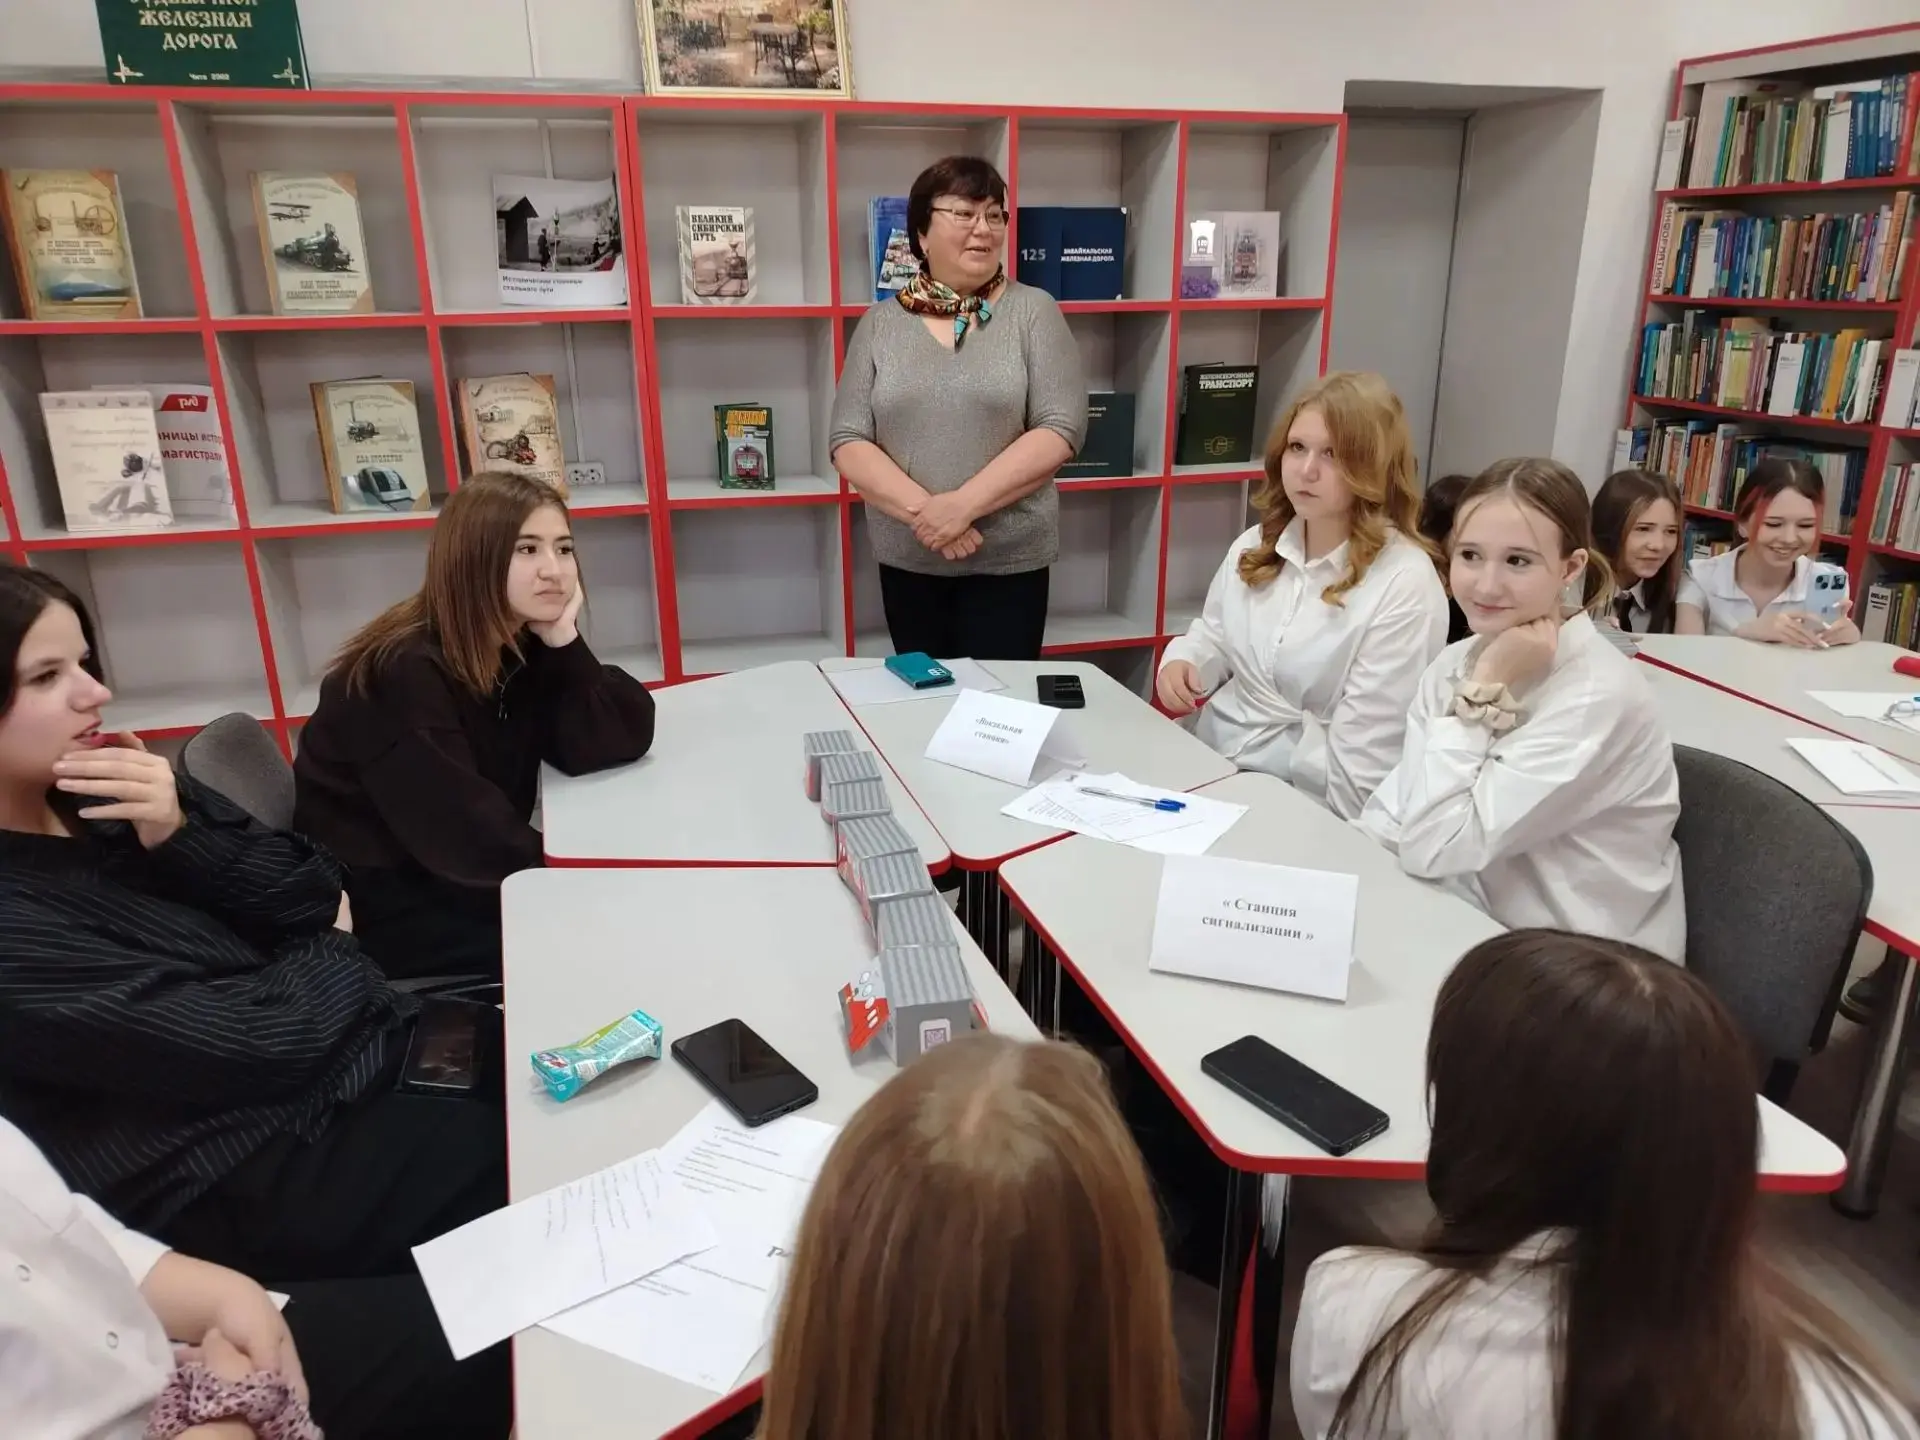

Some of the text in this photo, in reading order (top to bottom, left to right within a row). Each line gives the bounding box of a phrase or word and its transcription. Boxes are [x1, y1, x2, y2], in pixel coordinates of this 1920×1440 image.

[139, 10, 253, 28] ЖЕЛЕЗНАЯ
[162, 32, 238, 51] ДОРОГА
[691, 214, 733, 223] ВЕЛИКИЙ
[691, 223, 744, 232] СИБИРСКИЙ
[693, 232, 716, 241] ПУТЬ
[1021, 248, 1046, 261] 125
[1199, 378, 1254, 390] ТРАНСПОРТ
[1234, 898, 1297, 918] Станция
[1202, 916, 1301, 940] сигнализации
